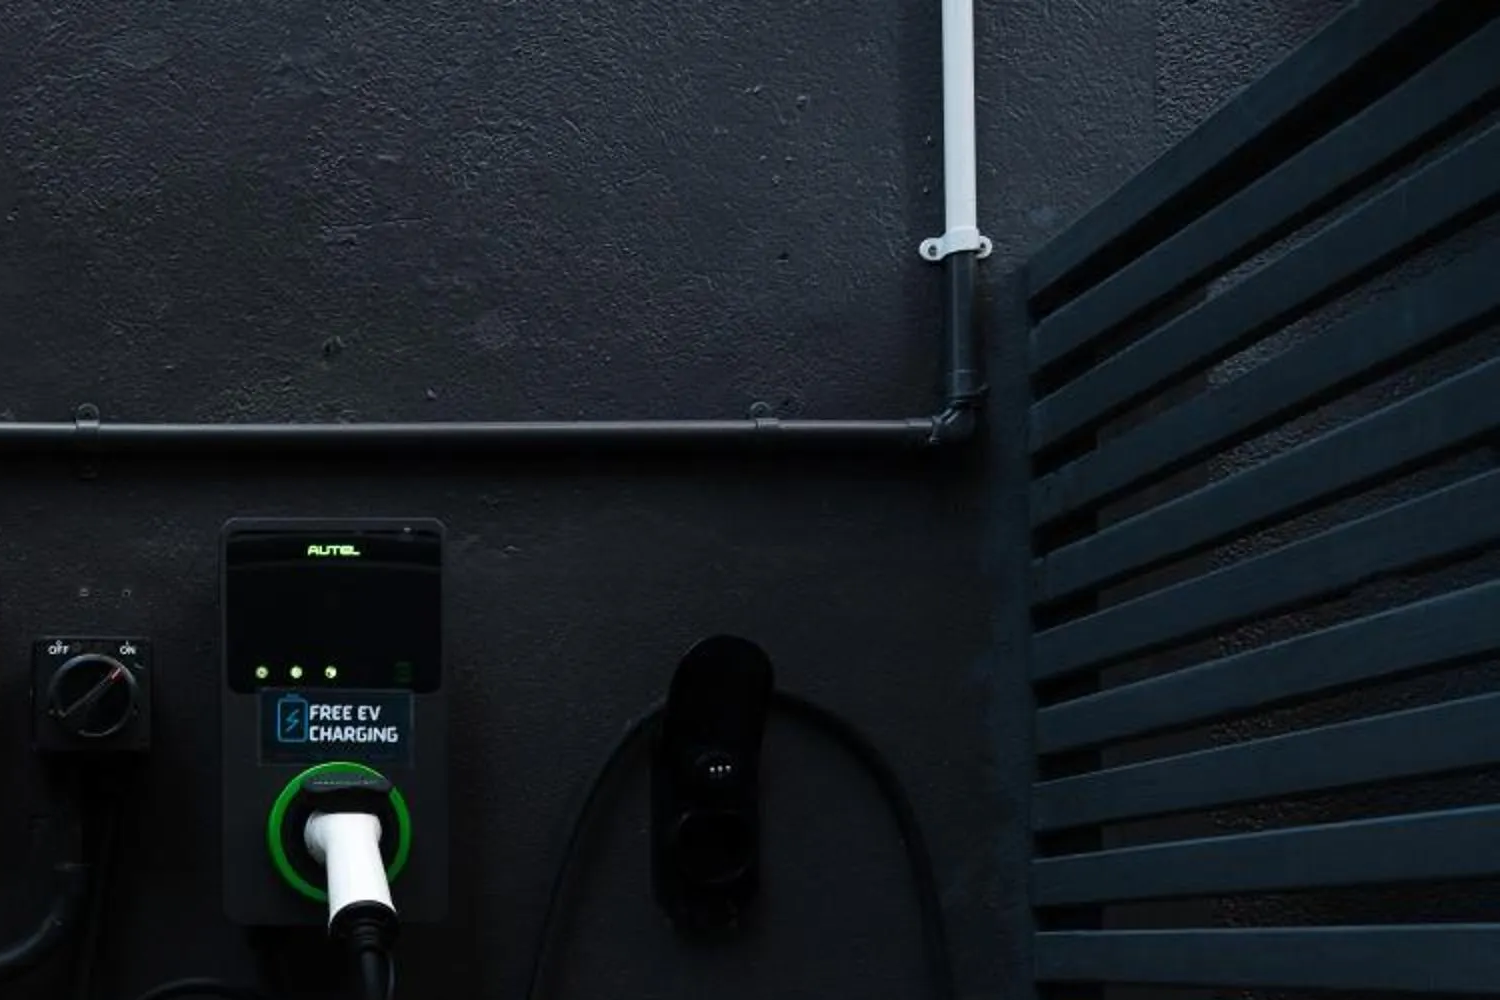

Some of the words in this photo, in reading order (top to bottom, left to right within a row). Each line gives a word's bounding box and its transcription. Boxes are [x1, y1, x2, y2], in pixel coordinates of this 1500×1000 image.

[307, 545, 361, 556] AUTEL
[309, 705, 353, 721] FREE
[357, 706, 381, 721] EV
[309, 726, 398, 743] CHARGING
